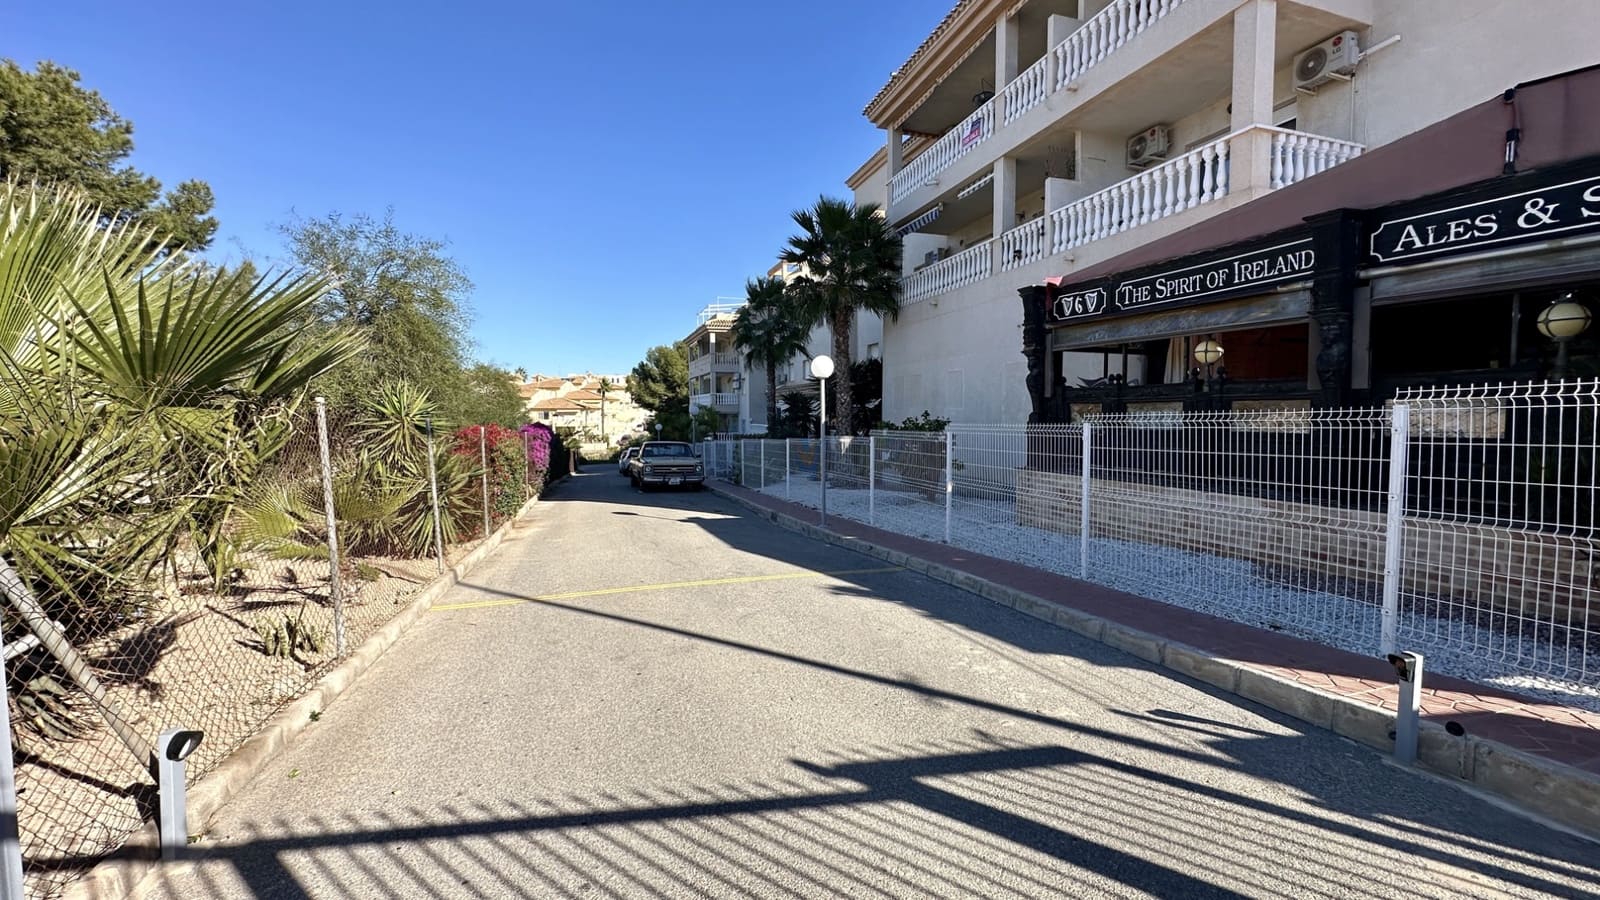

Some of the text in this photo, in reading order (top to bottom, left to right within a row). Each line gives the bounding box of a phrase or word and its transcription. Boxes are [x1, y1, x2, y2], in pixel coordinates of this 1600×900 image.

[1393, 214, 1498, 252] ALES
[1516, 198, 1561, 229] &
[1121, 250, 1315, 304] THE SPIRIT OF IRELAND
